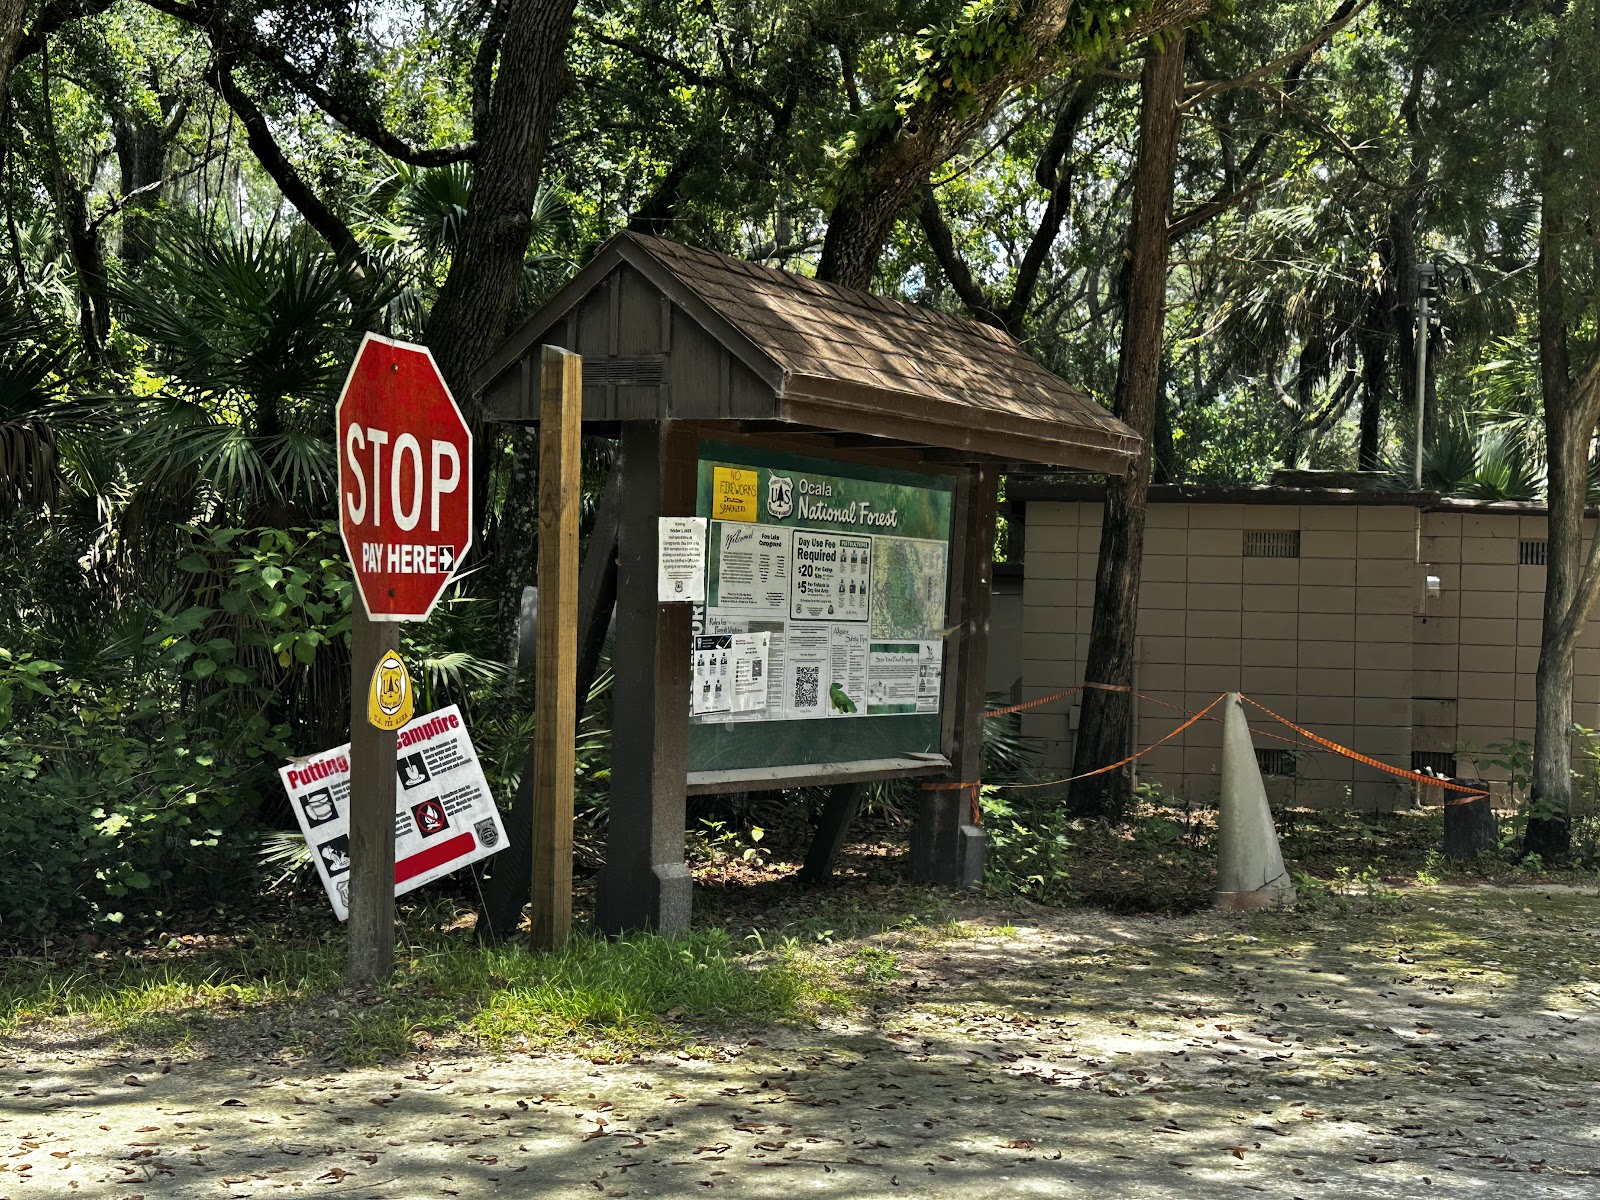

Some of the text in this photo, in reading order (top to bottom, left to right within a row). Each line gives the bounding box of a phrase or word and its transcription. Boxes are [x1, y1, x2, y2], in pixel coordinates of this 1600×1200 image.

[346, 422, 461, 531] STOP
[799, 479, 832, 496] Ocala
[798, 495, 897, 527] National Forest
[799, 537, 836, 549] Day Use Fee
[362, 542, 437, 574] PAY HERE
[797, 547, 837, 563] Required
[798, 564, 813, 577] $20
[798, 581, 807, 593] $5
[287, 754, 349, 790] Putting
